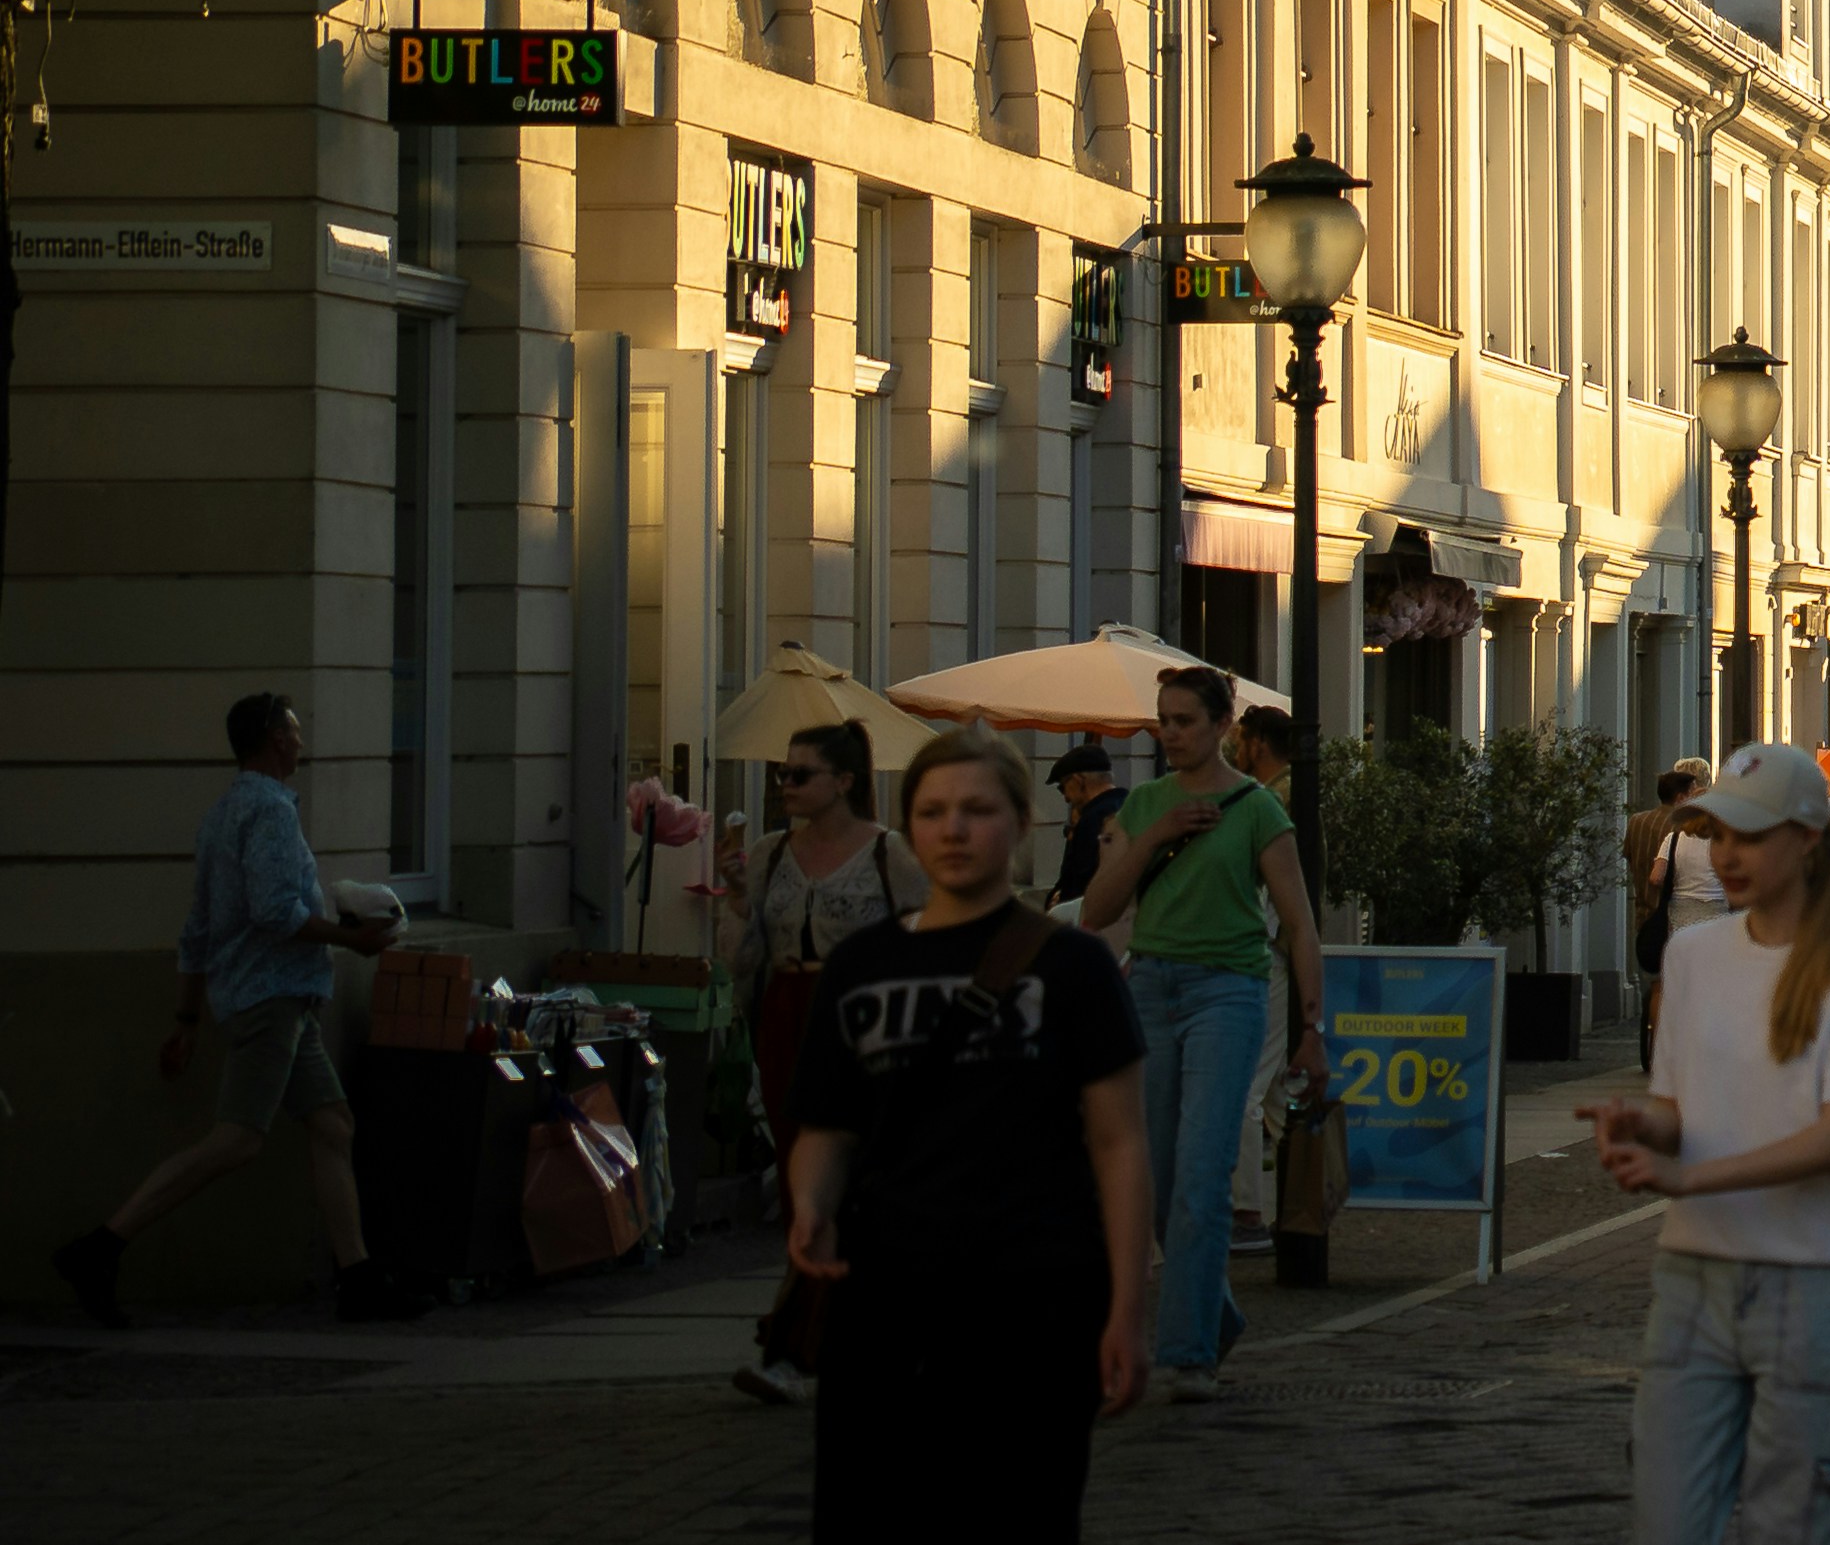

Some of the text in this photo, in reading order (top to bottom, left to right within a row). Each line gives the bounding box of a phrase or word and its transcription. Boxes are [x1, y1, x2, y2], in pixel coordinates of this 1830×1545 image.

[400, 37, 605, 85] BUTLERS
[11, 230, 265, 258] Hermann-Elflein-Straße
[1342, 1020, 1460, 1033] OUTDOOR WEEK
[1329, 1048, 1469, 1107] -20%
